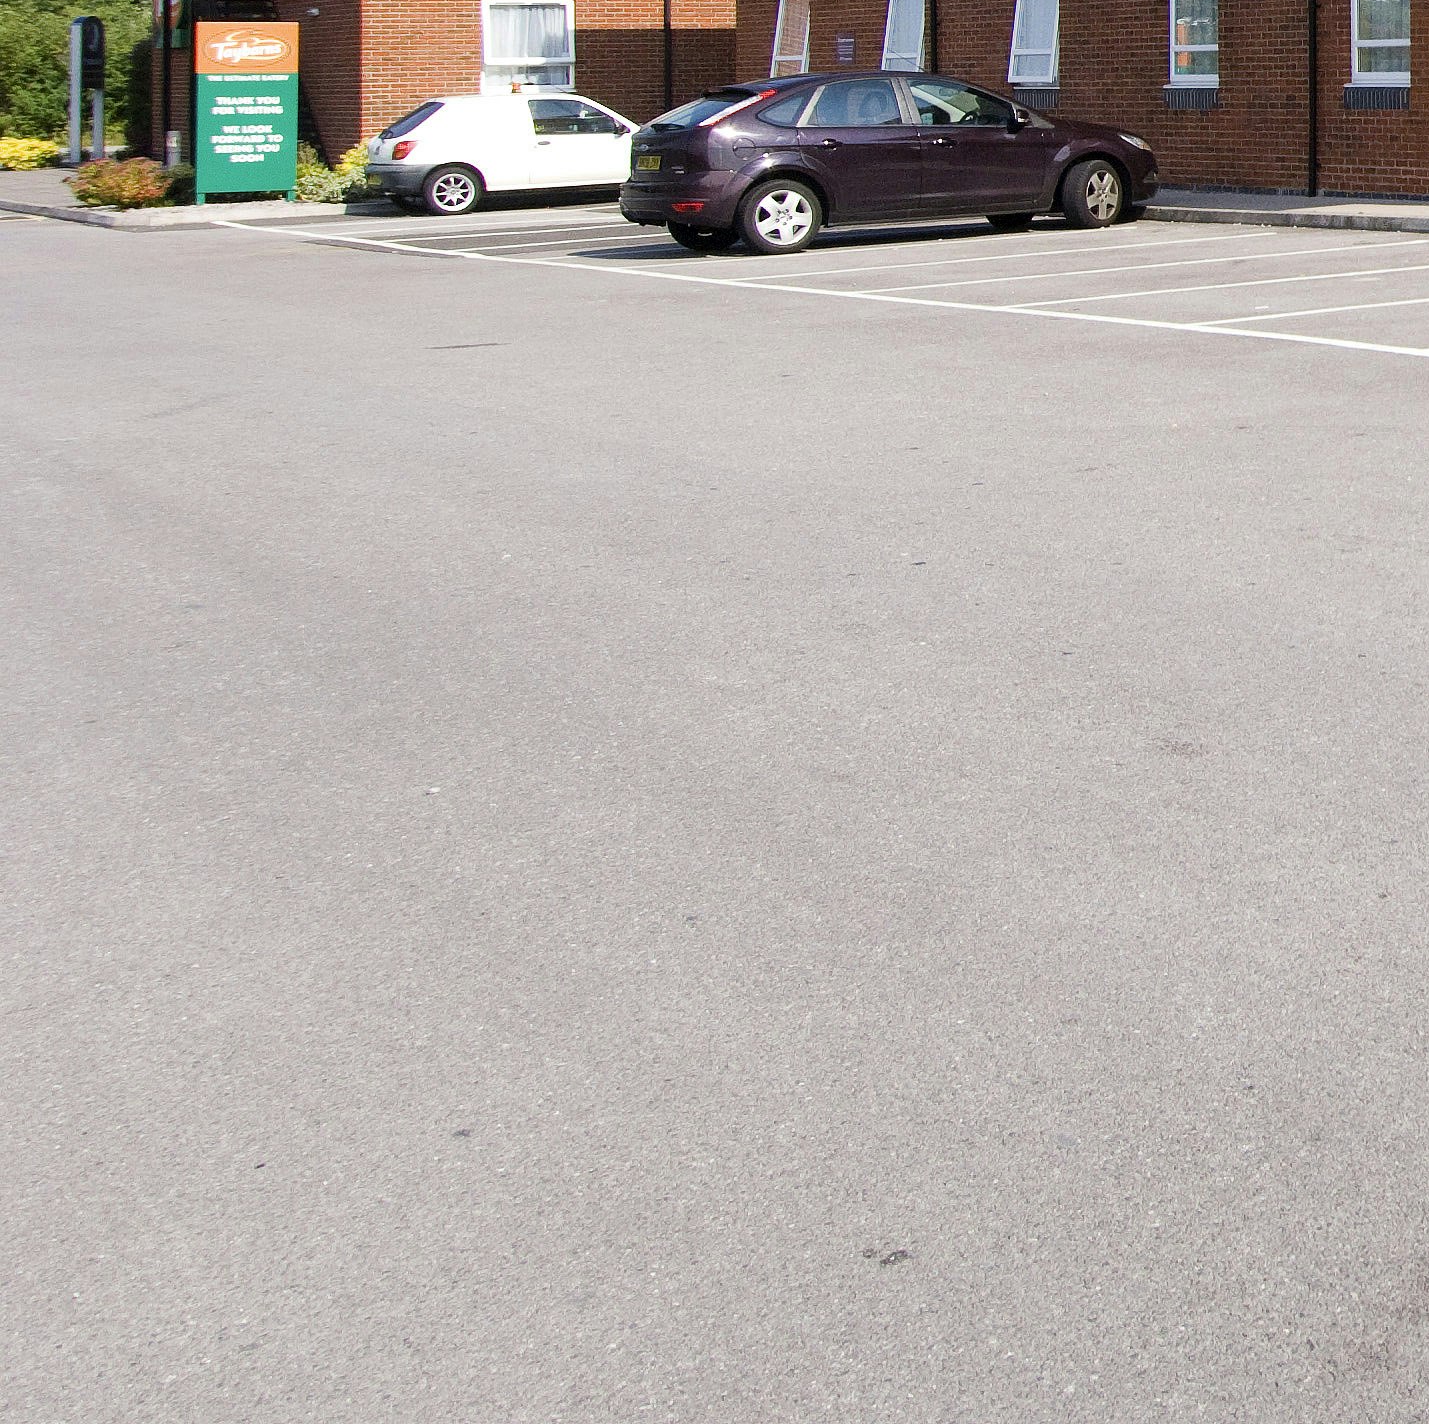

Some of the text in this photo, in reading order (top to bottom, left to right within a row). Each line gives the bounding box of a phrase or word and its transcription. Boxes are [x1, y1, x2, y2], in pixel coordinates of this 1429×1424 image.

[210, 41, 282, 63] Taybarns
[214, 96, 280, 105] THANK YOU
[235, 106, 284, 114] VISITING
[222, 125, 273, 134] WE LOOK
[211, 134, 284, 144] FORWARD TO
[214, 144, 280, 154] SEEING YOU
[230, 154, 264, 163] SOON
